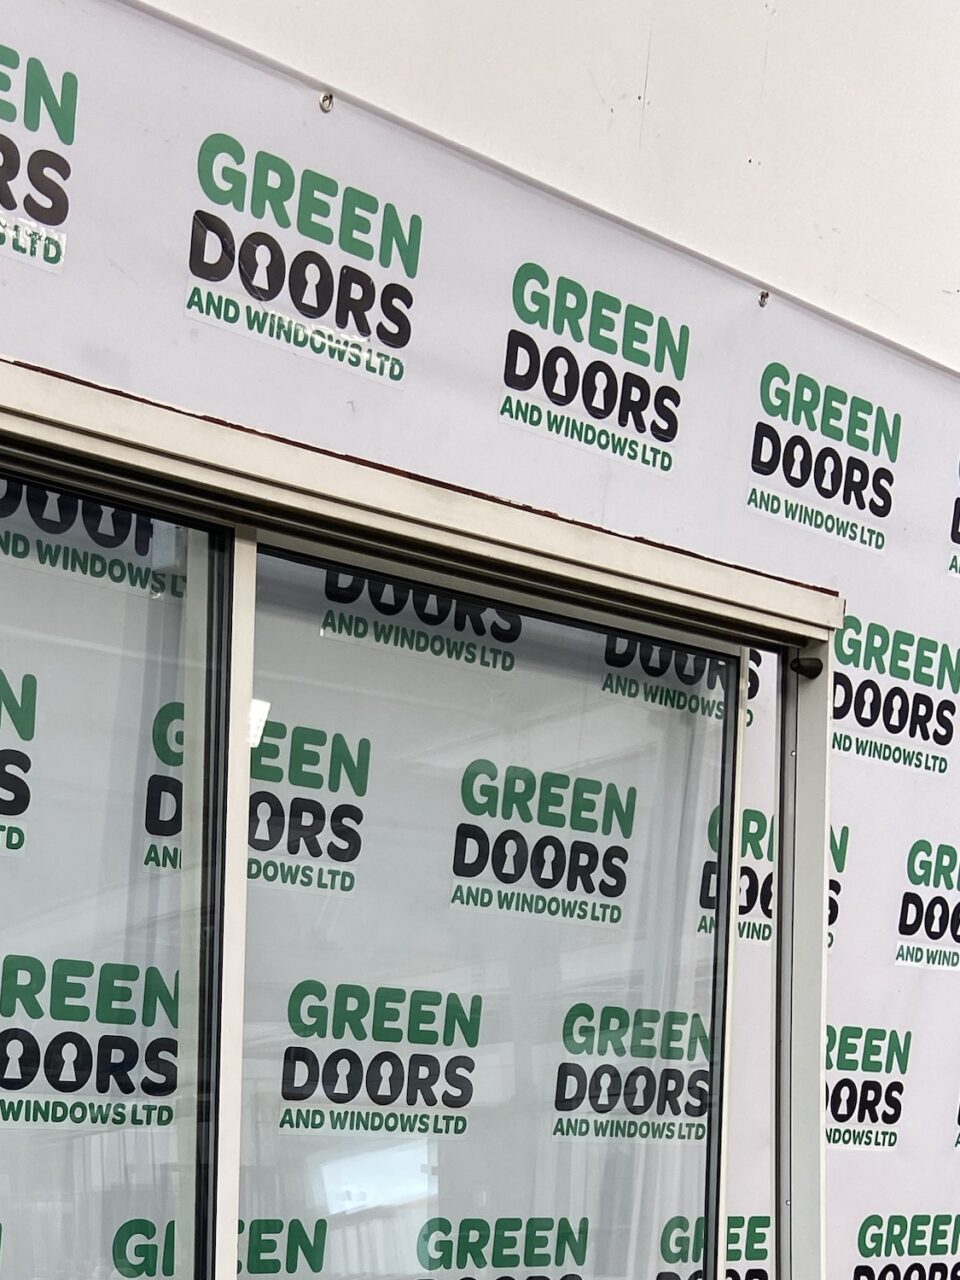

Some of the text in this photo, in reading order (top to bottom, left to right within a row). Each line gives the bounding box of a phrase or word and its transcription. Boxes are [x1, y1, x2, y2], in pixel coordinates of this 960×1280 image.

[197, 133, 422, 279] GREEN
[12, 224, 62, 265] LTD
[189, 209, 413, 349] DOORS
[186, 286, 405, 382] AND WINDOWS LTD
[512, 263, 690, 382] GREEN
[503, 329, 681, 443] DOORS
[760, 363, 902, 463] GREEN
[500, 395, 673, 472] AND WINDOWS LTD
[751, 422, 894, 518] DOORS
[747, 488, 885, 551] AND WINDOWS LTD
[36, 539, 166, 595] WINDOWS
[321, 609, 515, 671] AND WINDOWS LTD
[834, 615, 960, 694] GREEN
[602, 673, 639, 698] AND
[832, 731, 948, 774] ND WINDOWS LTD
[461, 759, 637, 839] GREEN
[317, 868, 355, 891] LTD
[453, 823, 628, 897] DOORS
[451, 884, 622, 923] AND WINDOWS LTD
[896, 945, 923, 965] AND
[288, 980, 483, 1048] GREEN
[281, 1046, 475, 1108] DOORS
[555, 1062, 710, 1117] DOORS
[0, 1099, 126, 1124] WINDOWS
[131, 1104, 174, 1126] LTD
[279, 1108, 467, 1134] AND WINDOWS LTD
[553, 1118, 706, 1140] AND WINDOWS LTD
[874, 1130, 897, 1147] LTD
[417, 1217, 589, 1271] GREEN
